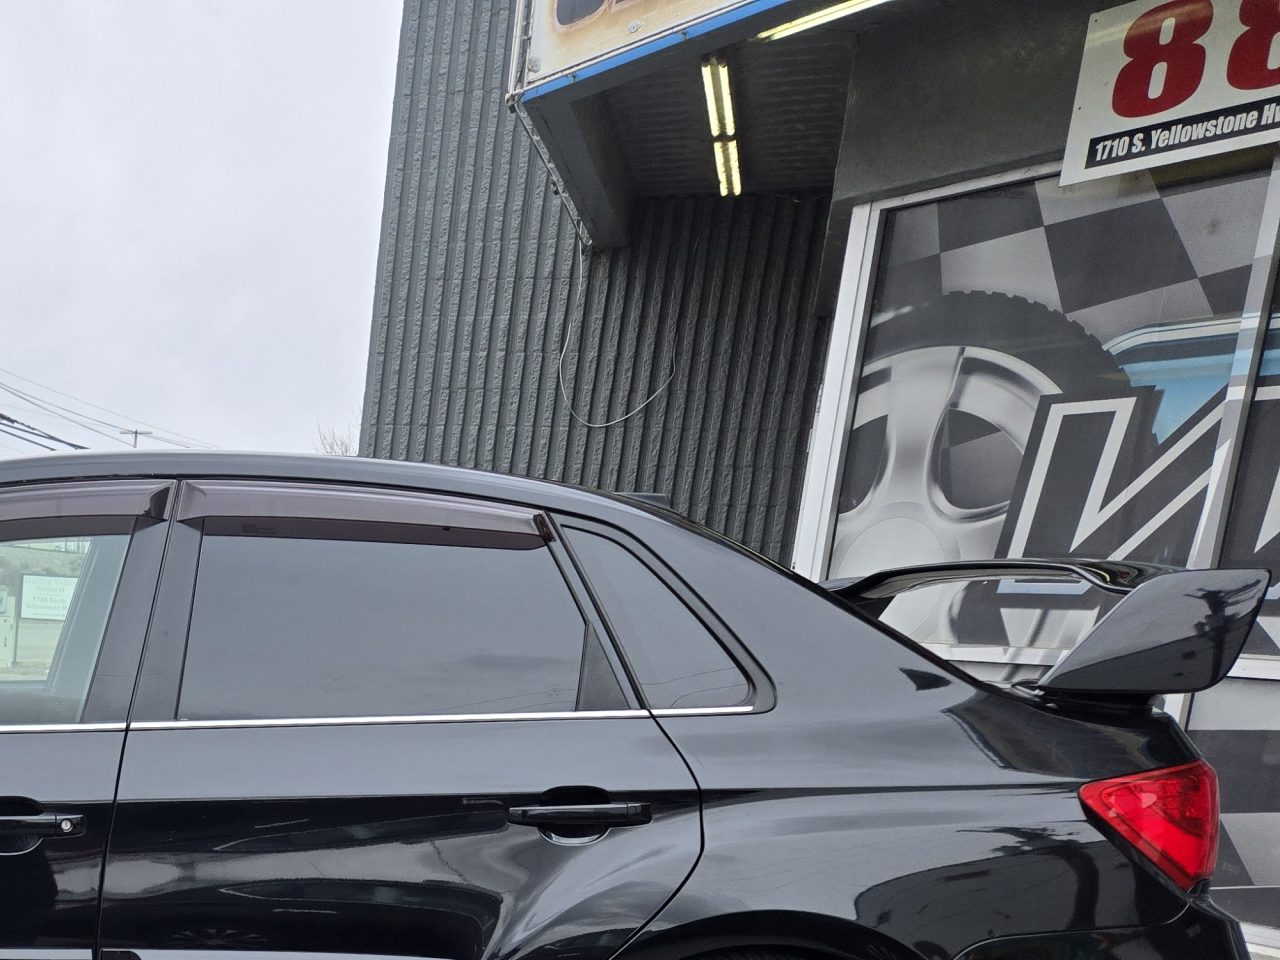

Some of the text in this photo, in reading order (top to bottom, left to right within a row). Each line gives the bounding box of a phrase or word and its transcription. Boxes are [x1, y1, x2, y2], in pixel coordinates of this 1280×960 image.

[1095, 138, 1130, 162] 1710
[1131, 132, 1146, 154] S.
[1150, 109, 1258, 149] Yellowstone
